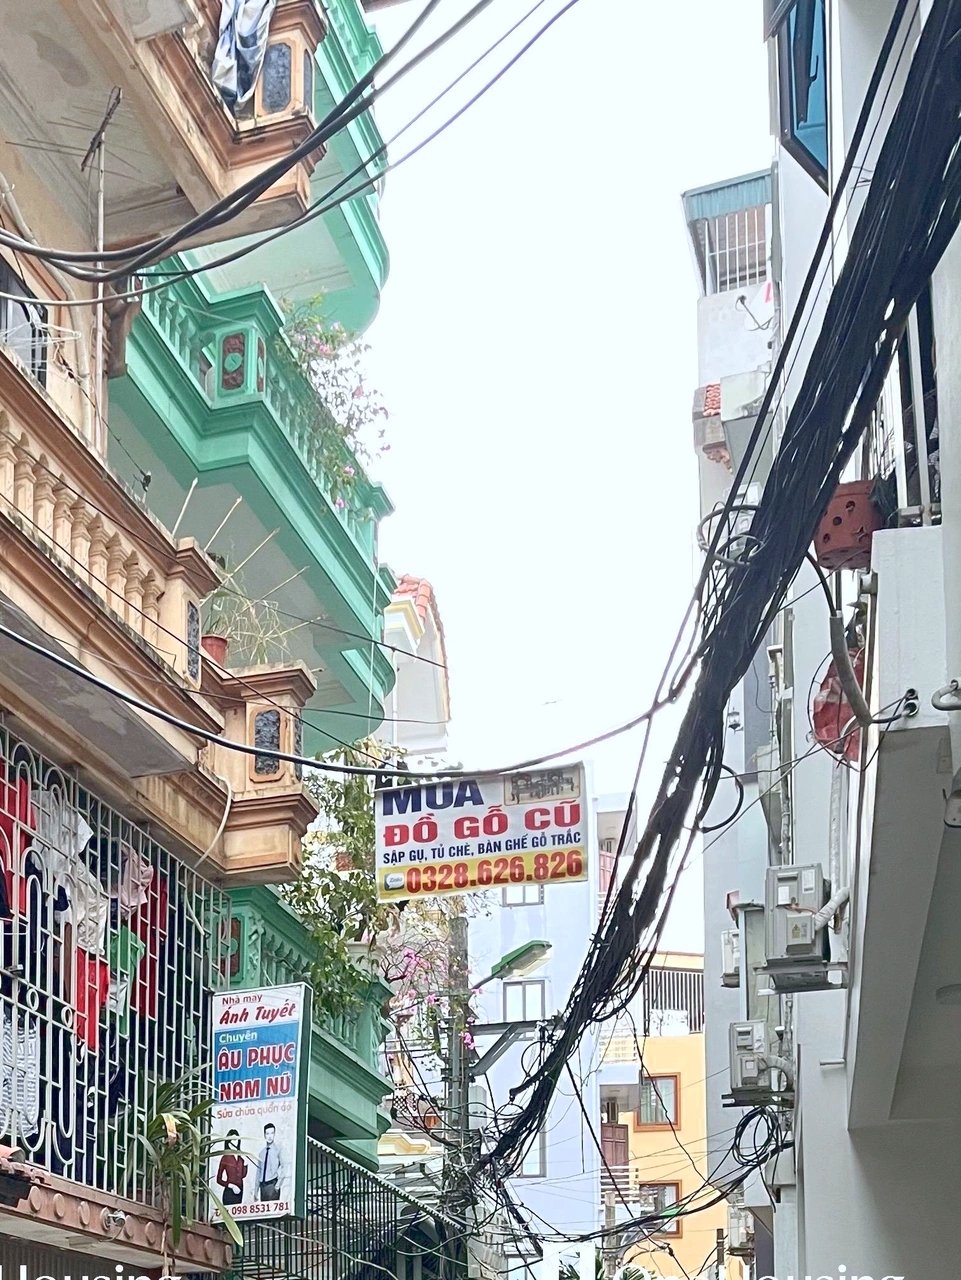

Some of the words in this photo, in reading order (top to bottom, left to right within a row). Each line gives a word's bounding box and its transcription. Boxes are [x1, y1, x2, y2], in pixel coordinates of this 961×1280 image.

[383, 780, 484, 816] MUA
[383, 812, 438, 847] ĐỒ
[454, 804, 508, 840] GỖ
[524, 800, 580, 830] CŨ
[383, 849, 405, 866] SẬP
[431, 843, 445, 859] TỦ
[478, 839, 501, 855] BÀN
[505, 833, 529, 851] GHẾ
[531, 831, 547, 848] GỖ
[551, 828, 581, 846] TRẮC
[406, 849, 583, 894] 0328.626.826
[219, 1006, 249, 1025] Ánh
[255, 999, 296, 1024] Tuyết
[222, 995, 240, 1005] Nhà
[243, 993, 263, 1003] may
[219, 1030, 258, 1043] Chuyên
[218, 1047, 242, 1071] ÂU
[248, 1043, 295, 1068] PHỤC
[220, 1079, 260, 1101] NAM
[266, 1072, 292, 1096] NỮ
[231, 1205, 248, 1215] 098
[249, 1203, 271, 1214] 8531
[273, 1201, 290, 1212] 781
